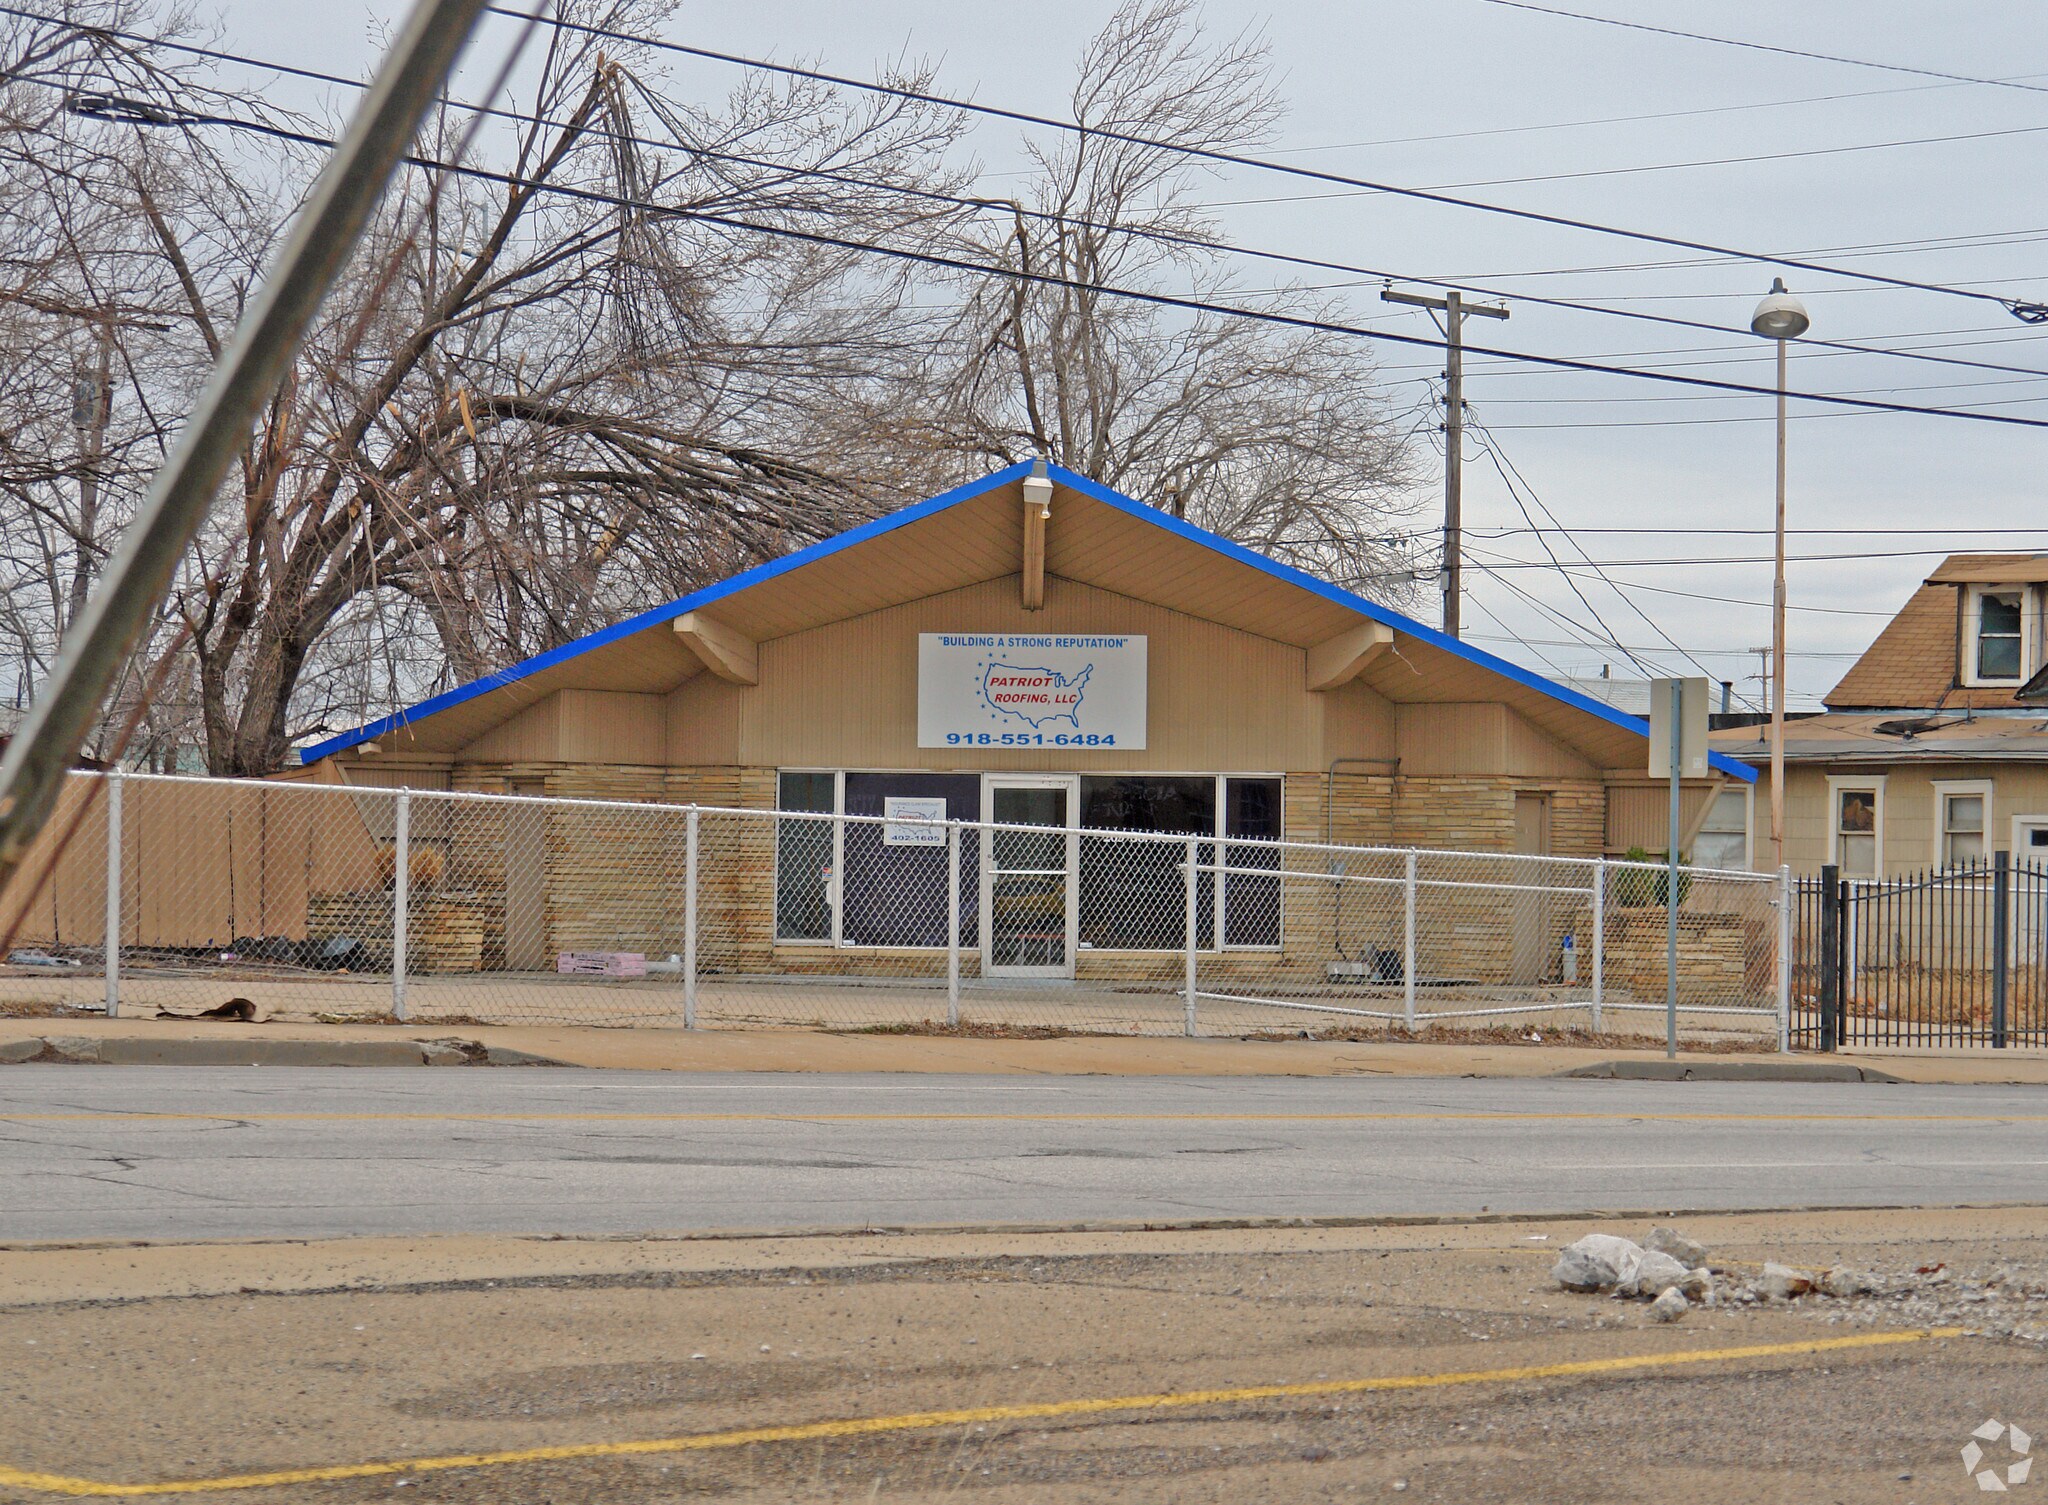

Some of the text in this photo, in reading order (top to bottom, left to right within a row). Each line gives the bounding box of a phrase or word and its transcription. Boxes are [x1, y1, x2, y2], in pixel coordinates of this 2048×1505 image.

[938, 636, 1129, 648] "BUILDING A STRONG REPUTATION"
[989, 677, 1053, 687] PATRIOT
[994, 693, 1077, 705] ROOFING, LLC
[946, 733, 1116, 746] 918-551-6484
